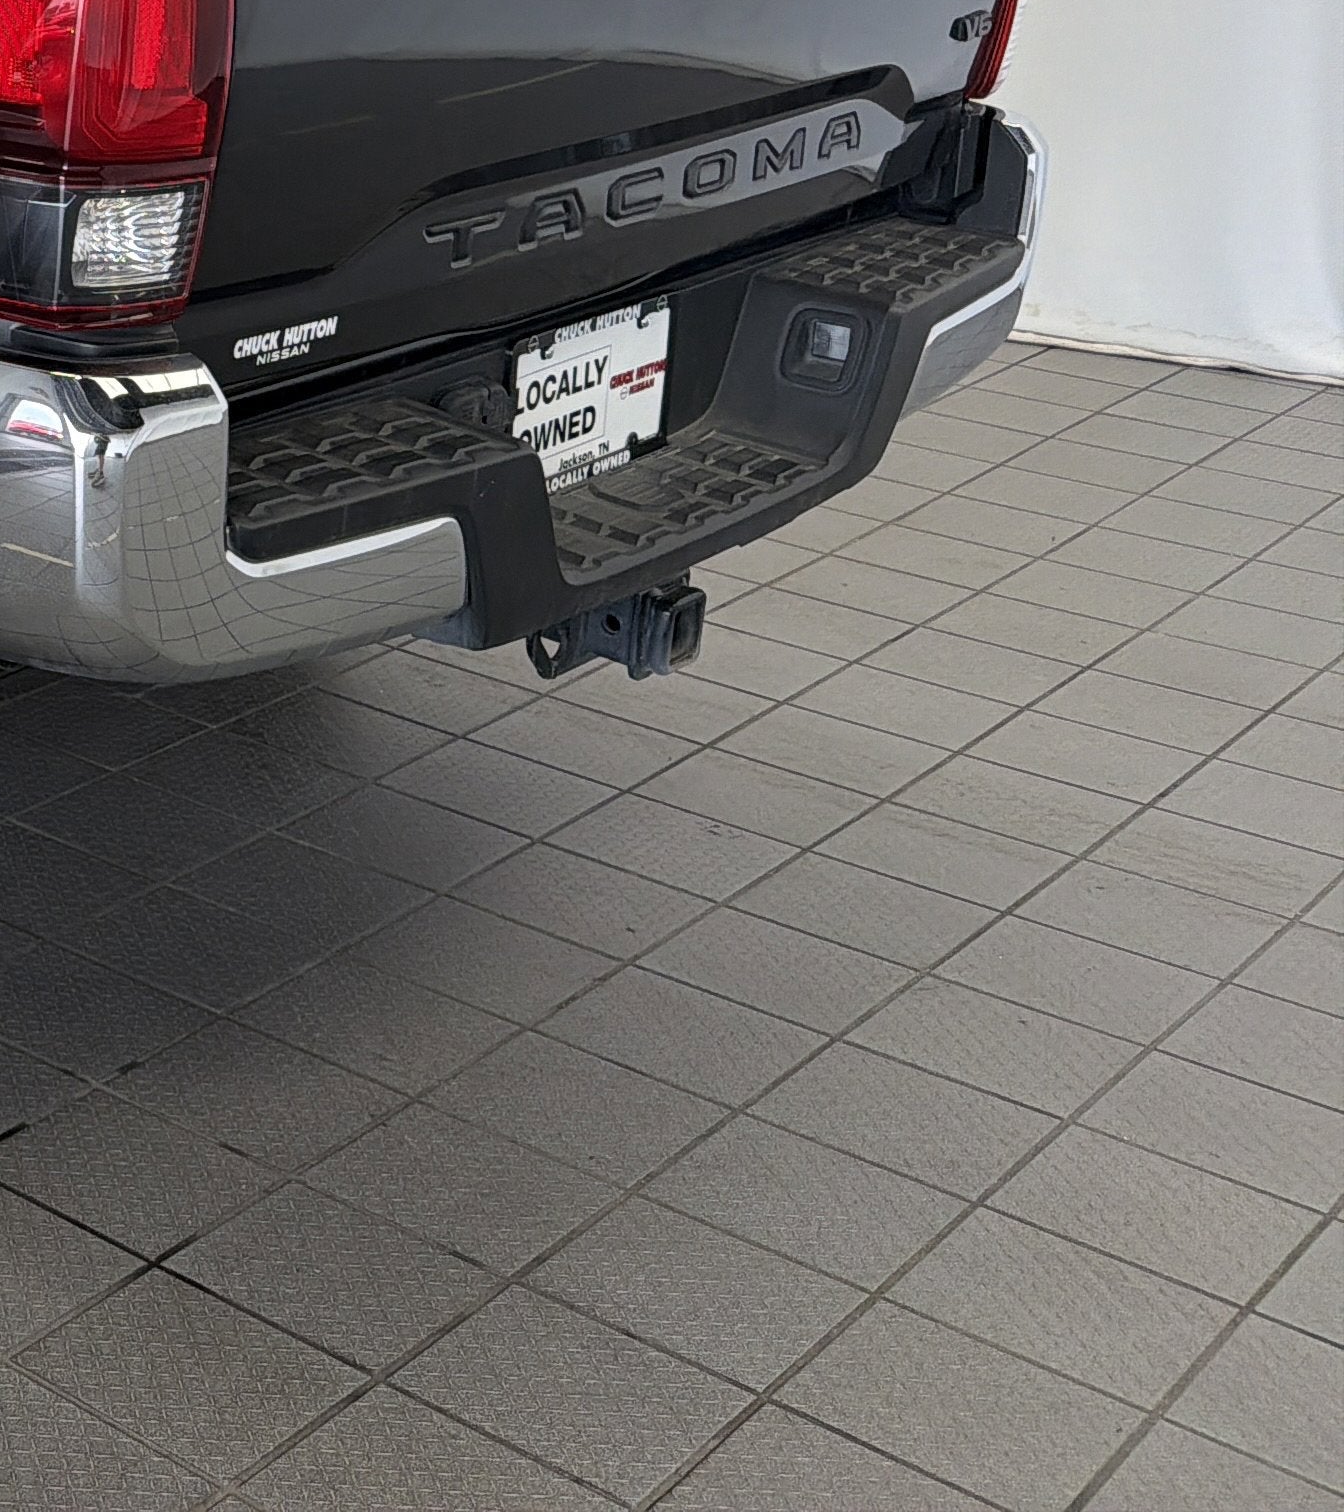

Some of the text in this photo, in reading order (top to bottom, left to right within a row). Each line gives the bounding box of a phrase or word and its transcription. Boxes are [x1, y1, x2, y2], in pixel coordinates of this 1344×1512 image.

[421, 109, 862, 270] TACOMA
[233, 315, 339, 360] CHUCK HUTTON
[554, 303, 642, 345] CHUCK HUTTON
[255, 342, 310, 367] NISSAN
[514, 355, 609, 416] LOCALLY
[545, 449, 631, 494] LOCALLY OWNED
[559, 440, 610, 471] Jackson, TN
